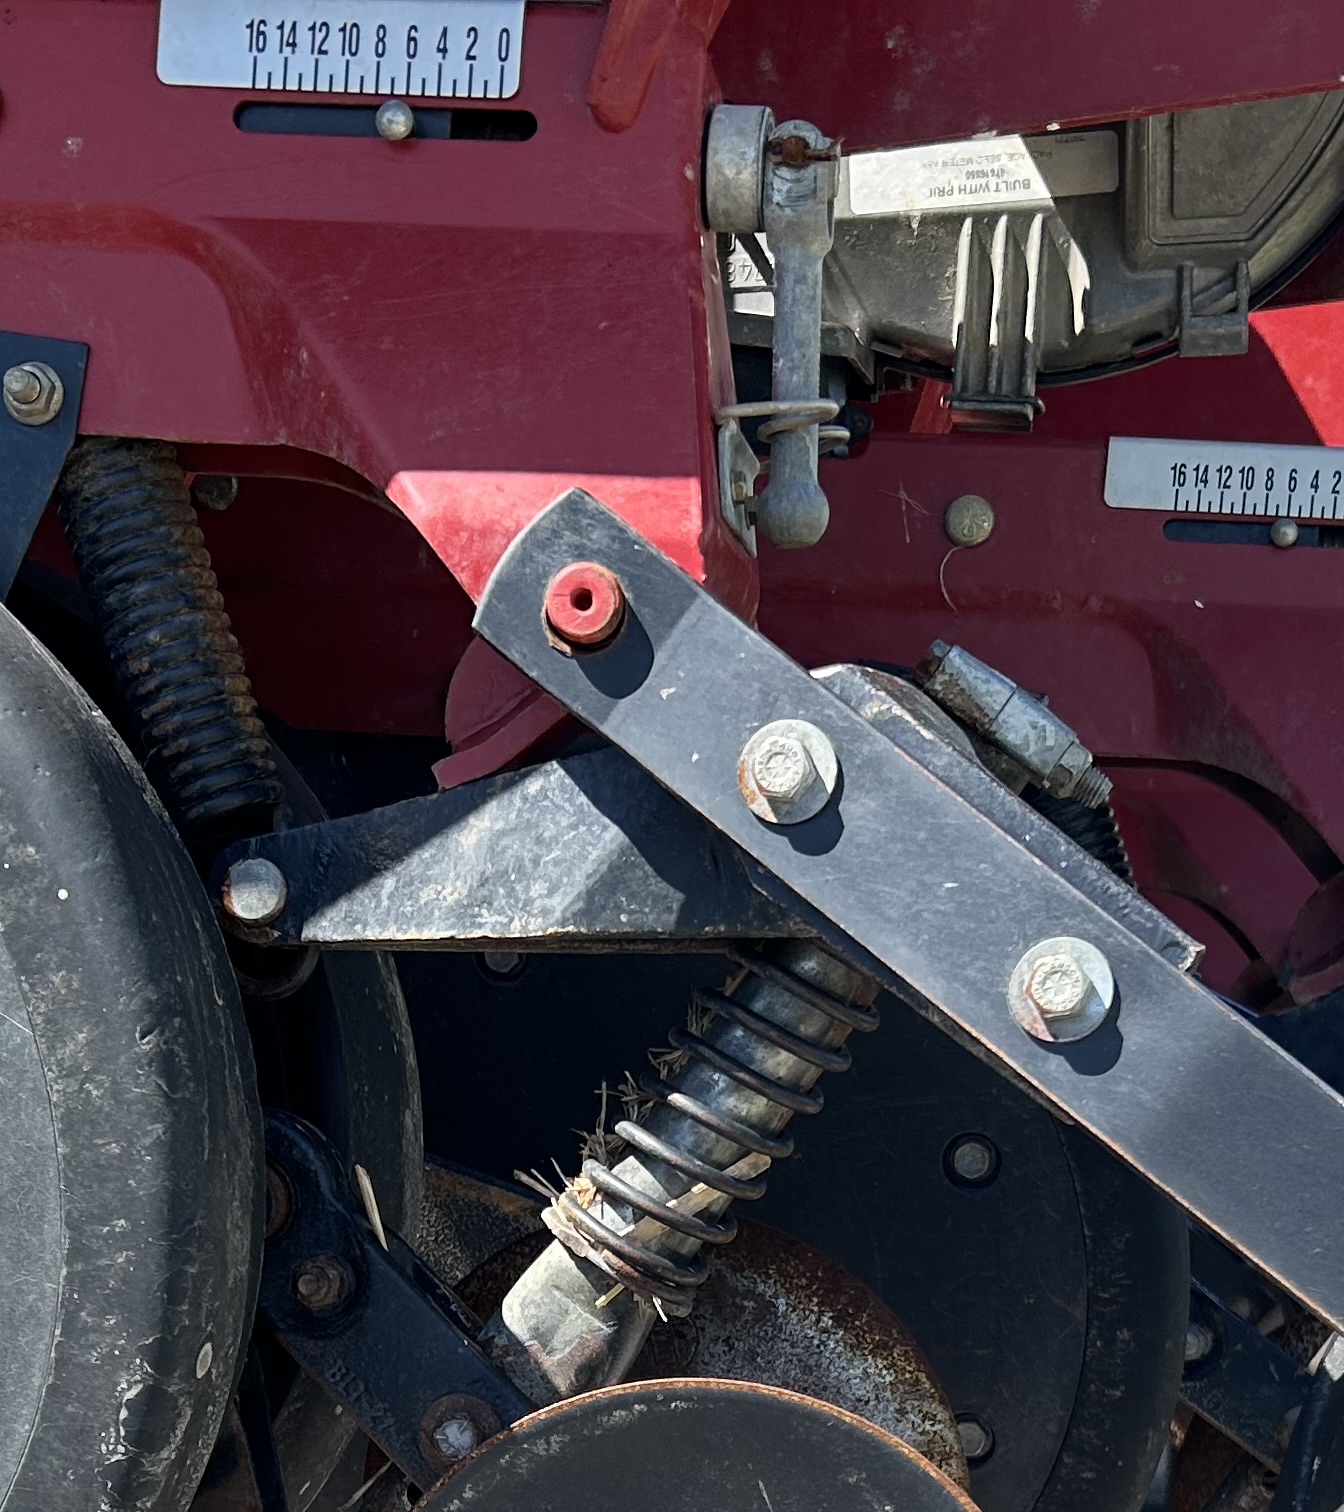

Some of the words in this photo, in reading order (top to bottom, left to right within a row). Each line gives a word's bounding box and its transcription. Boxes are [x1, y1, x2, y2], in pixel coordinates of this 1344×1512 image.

[245, 18, 268, 54] 16
[276, 19, 298, 55] 14
[307, 20, 330, 56] 12
[338, 22, 361, 58] 10
[374, 23, 387, 59] 8
[406, 24, 419, 60] 6
[436, 26, 449, 61] 4
[465, 26, 479, 62] 2
[497, 27, 511, 63] 0
[958, 182, 991, 195] WITH
[993, 178, 1031, 193] BUILT
[1170, 462, 1188, 488] 16
[1192, 463, 1210, 489] 14
[1215, 464, 1233, 490] 12
[1238, 465, 1256, 492] 10
[1264, 467, 1275, 493] 8
[1287, 468, 1298, 494] 6
[1309, 469, 1320, 494] 4
[1330, 469, 1342, 495] 2
